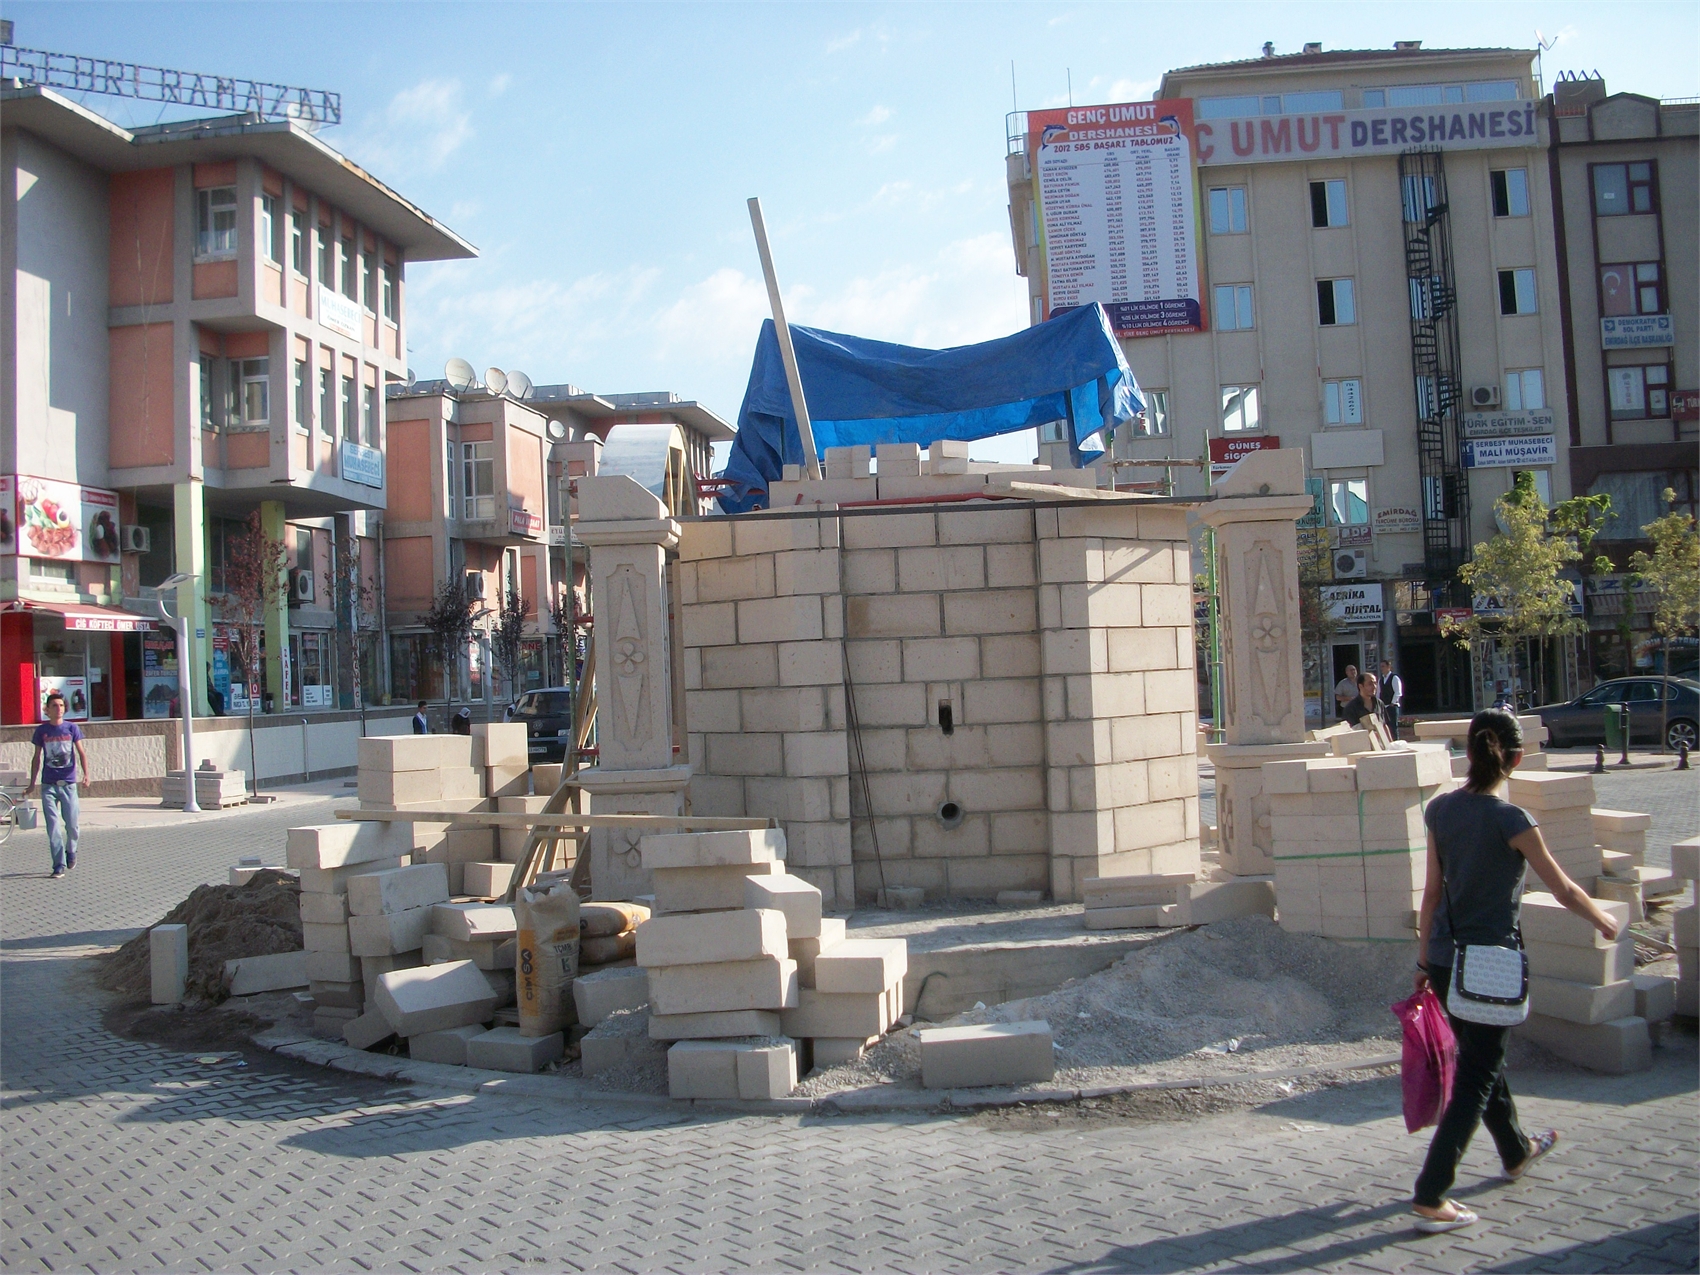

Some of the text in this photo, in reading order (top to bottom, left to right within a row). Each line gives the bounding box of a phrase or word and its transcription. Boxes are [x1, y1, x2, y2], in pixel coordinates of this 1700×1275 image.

[161, 68, 342, 124] RAMAZAN
[1067, 105, 1157, 125] GENÇ UMUT
[1068, 123, 1158, 141] DERSHANESİ
[1229, 115, 1346, 158] UMUT
[1350, 102, 1536, 148] DERSHANESİ
[1053, 145, 1071, 153] 2012
[1094, 140, 1127, 150] BAŞARI
[1131, 136, 1174, 147] TABLOMUZ
[1532, 416, 1552, 425] SEN
[1228, 440, 1262, 451] GÜNEŞ
[1475, 437, 1553, 448] SERBEST MUHASEBECİ
[1223, 450, 1248, 461] SİGO
[1479, 445, 1548, 458] MALİ MÜŞAVİR
[1377, 508, 1418, 519] EMİRDAĞ
[1344, 603, 1382, 615] DİJİTAL
[88, 618, 115, 630] KÖFTECİ
[116, 620, 134, 630] ÖMER
[135, 621, 151, 631] USTA
